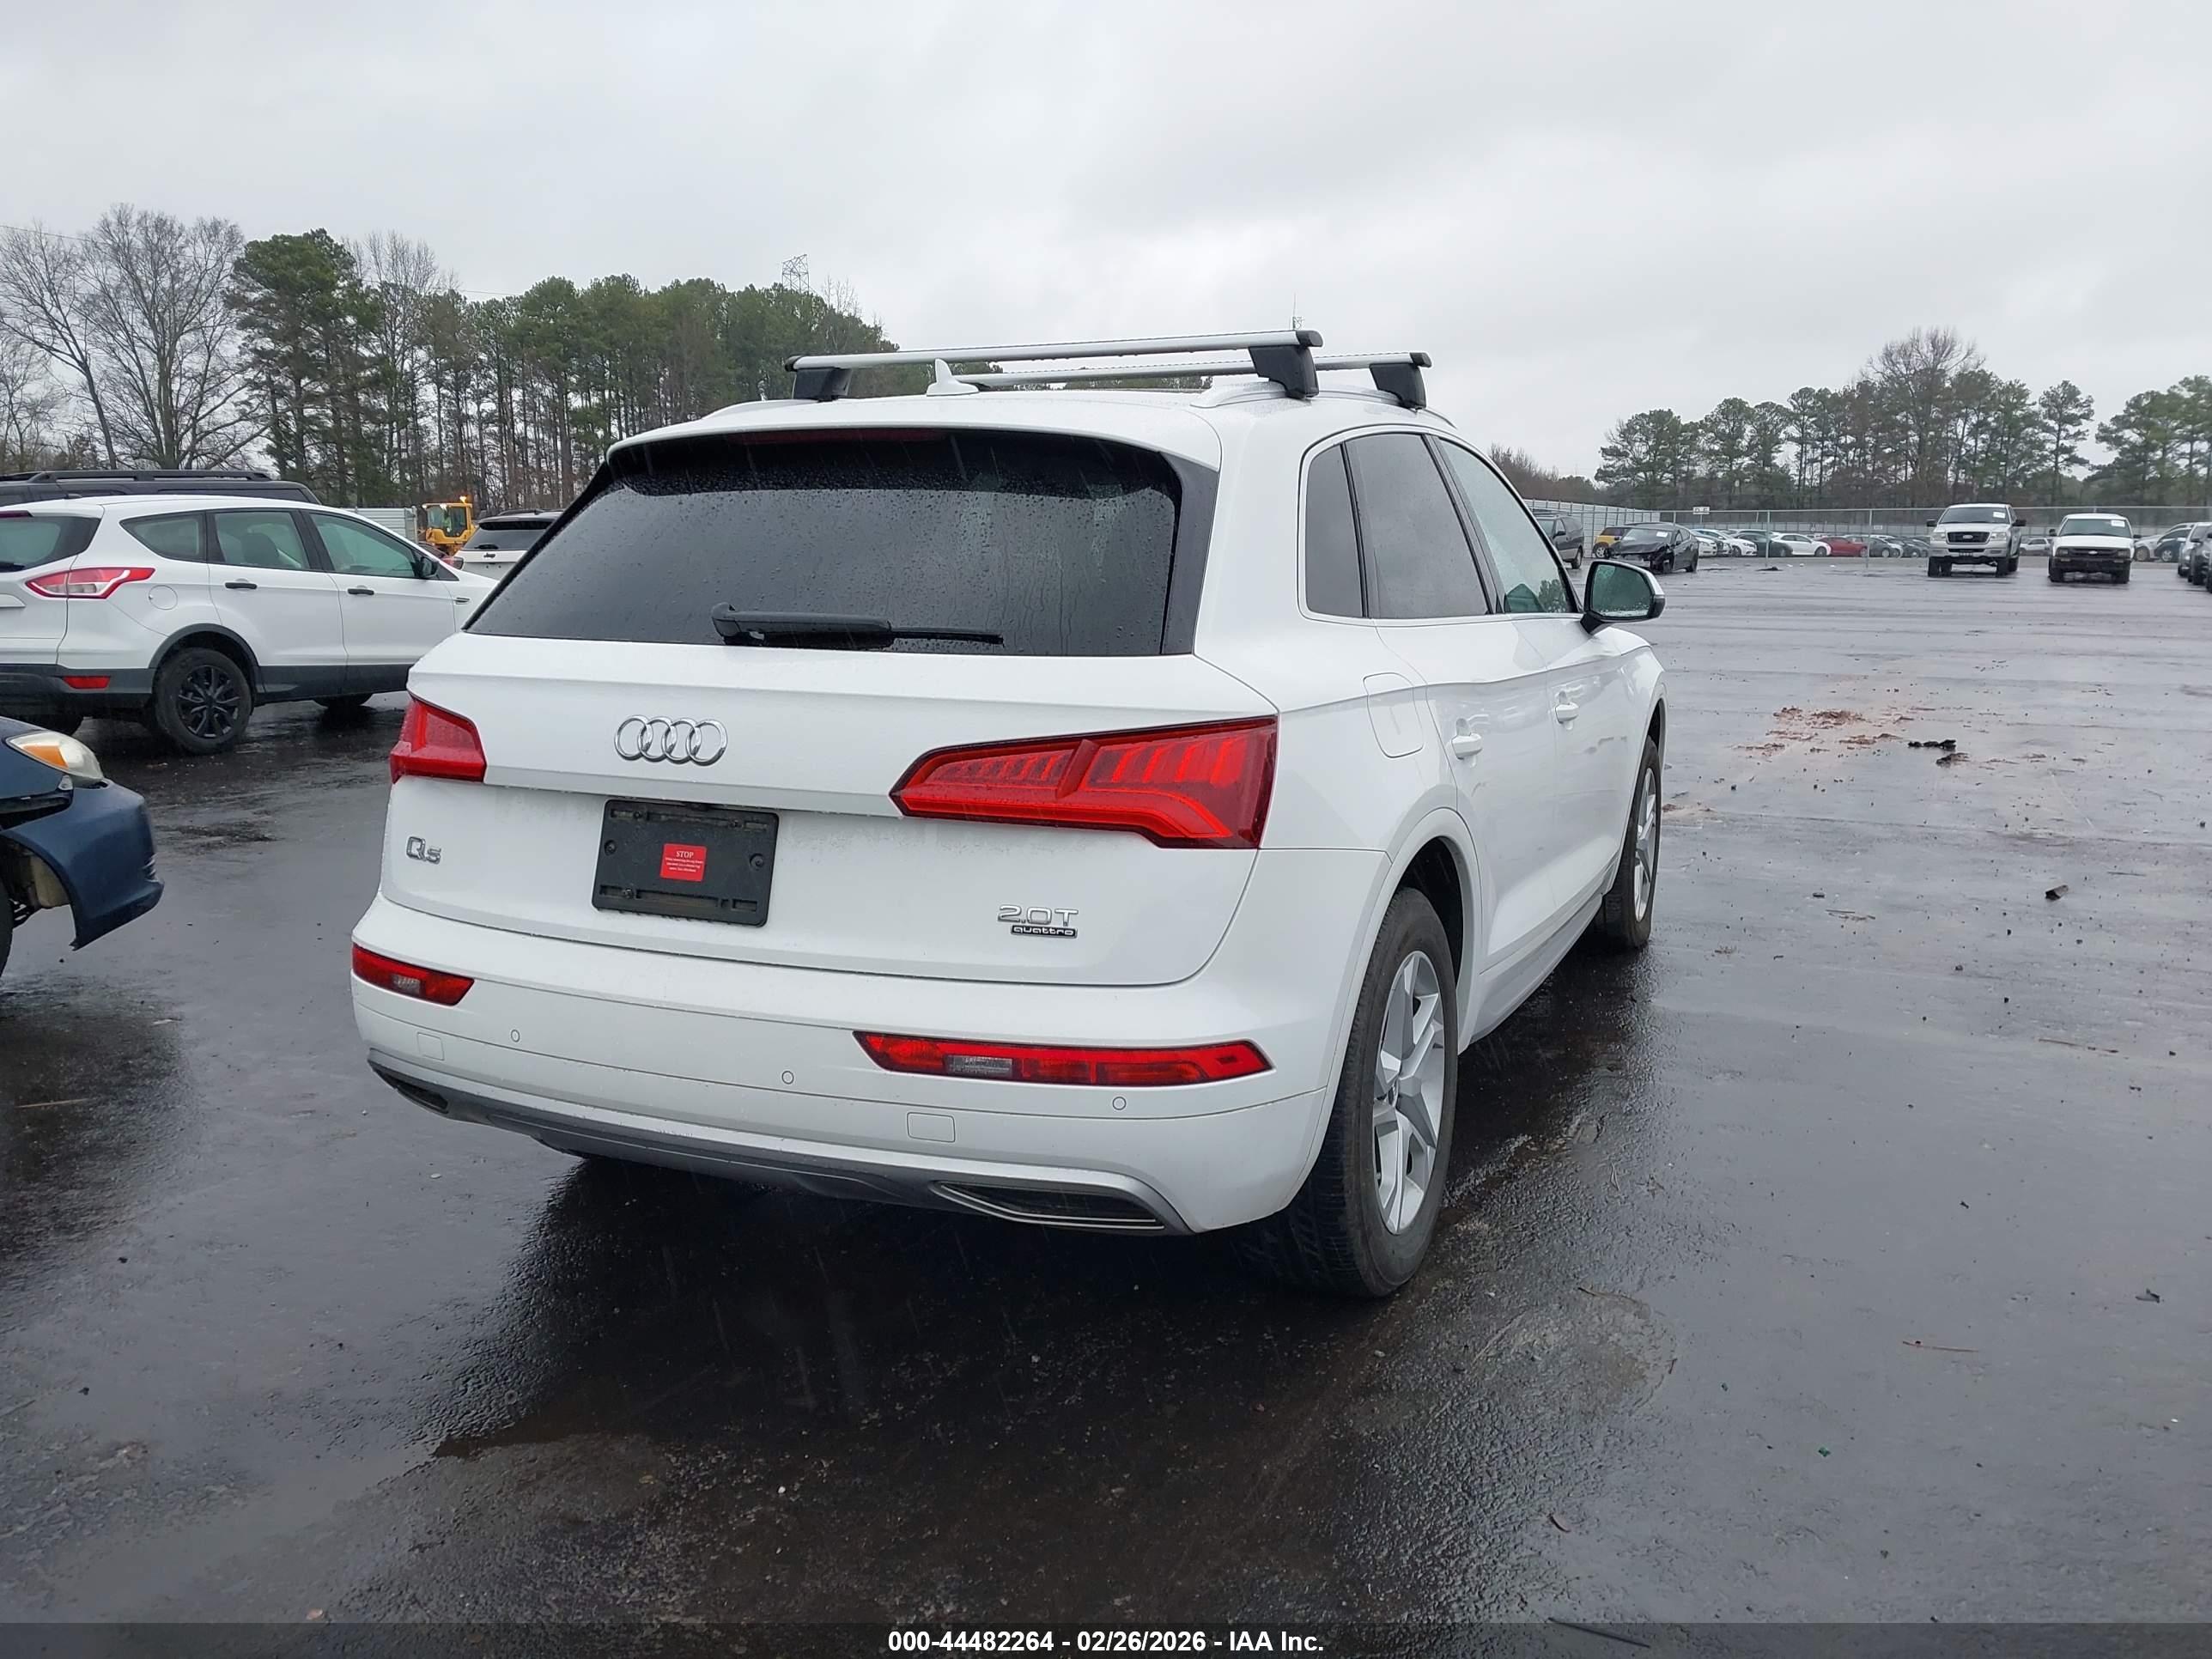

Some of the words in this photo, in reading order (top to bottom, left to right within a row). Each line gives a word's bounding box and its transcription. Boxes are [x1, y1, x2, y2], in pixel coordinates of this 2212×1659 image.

[406, 836, 441, 865] Q5
[998, 904, 1079, 927] 2.0T
[1012, 926, 1075, 937] quattro
